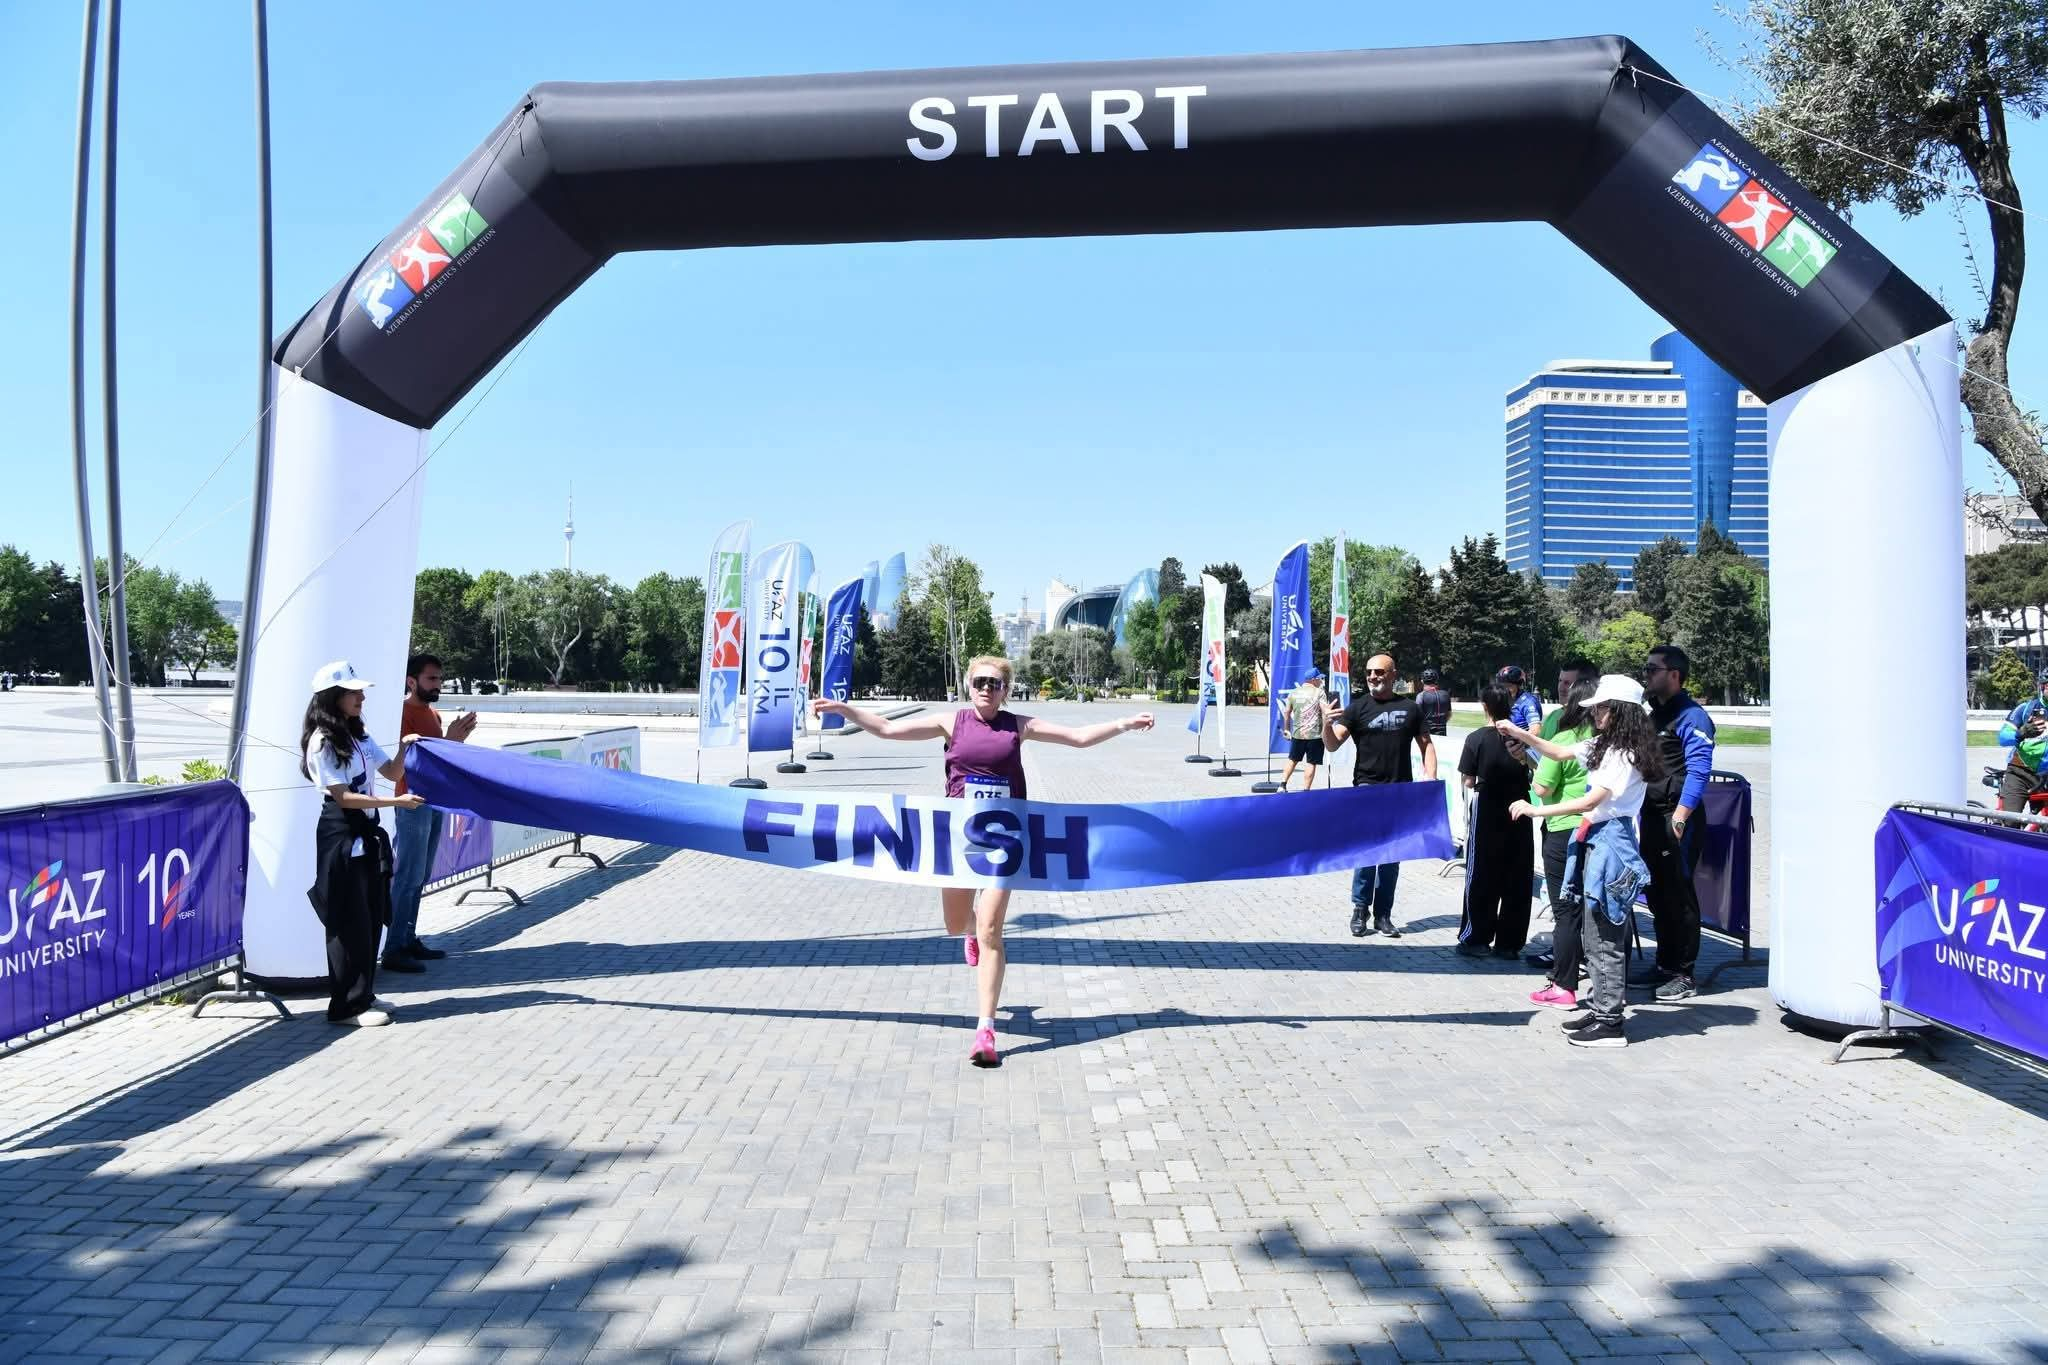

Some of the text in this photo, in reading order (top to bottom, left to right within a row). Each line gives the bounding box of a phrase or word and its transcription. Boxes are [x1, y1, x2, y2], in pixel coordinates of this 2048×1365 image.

[906, 85, 1207, 162] START
[1664, 185, 1712, 224] AZERBAIJAN
[1711, 224, 1751, 259] ATHLETICS
[385, 298, 423, 336] AZERBAIJAN
[423, 265, 457, 300] ATHLETICS
[456, 228, 497, 267] FEDERATION
[759, 628, 790, 672] 10
[754, 680, 770, 714] KM
[743, 798, 1090, 880] FINISH
[137, 848, 191, 929] 10
[177, 908, 196, 920] YEARS
[1931, 878, 2047, 961] UFAZ
[0, 929, 106, 979] NIVERSITY
[1935, 943, 2046, 994] UNIVERSITY
